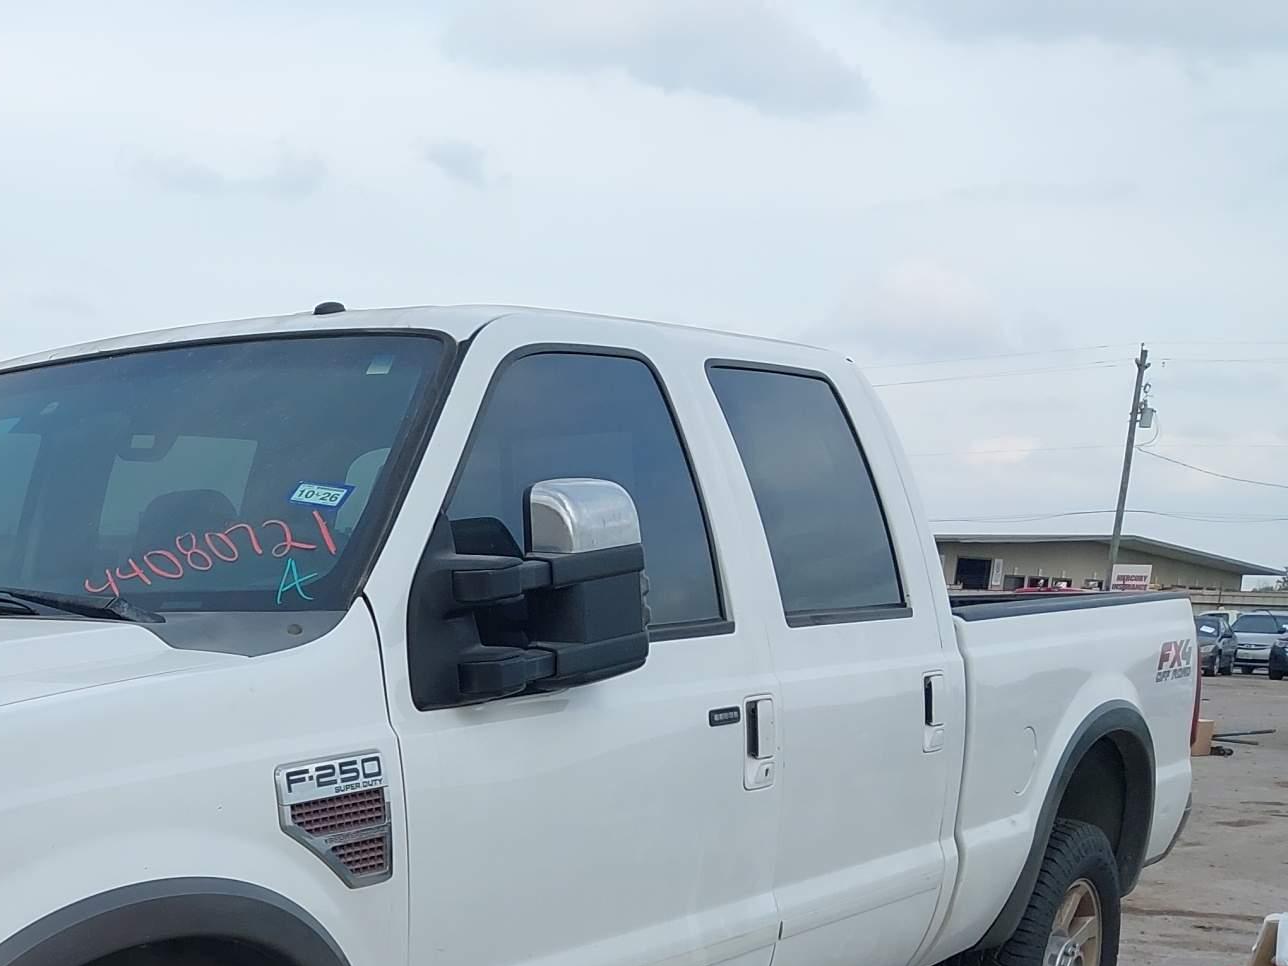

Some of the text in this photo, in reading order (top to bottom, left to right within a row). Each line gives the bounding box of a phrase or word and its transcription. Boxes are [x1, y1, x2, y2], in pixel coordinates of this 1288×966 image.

[84, 510, 337, 597] 44080721
[276, 558, 318, 604] A
[1158, 639, 1192, 670] FX4
[286, 756, 382, 793] F-250
[335, 778, 383, 793] SUPER DUTY
